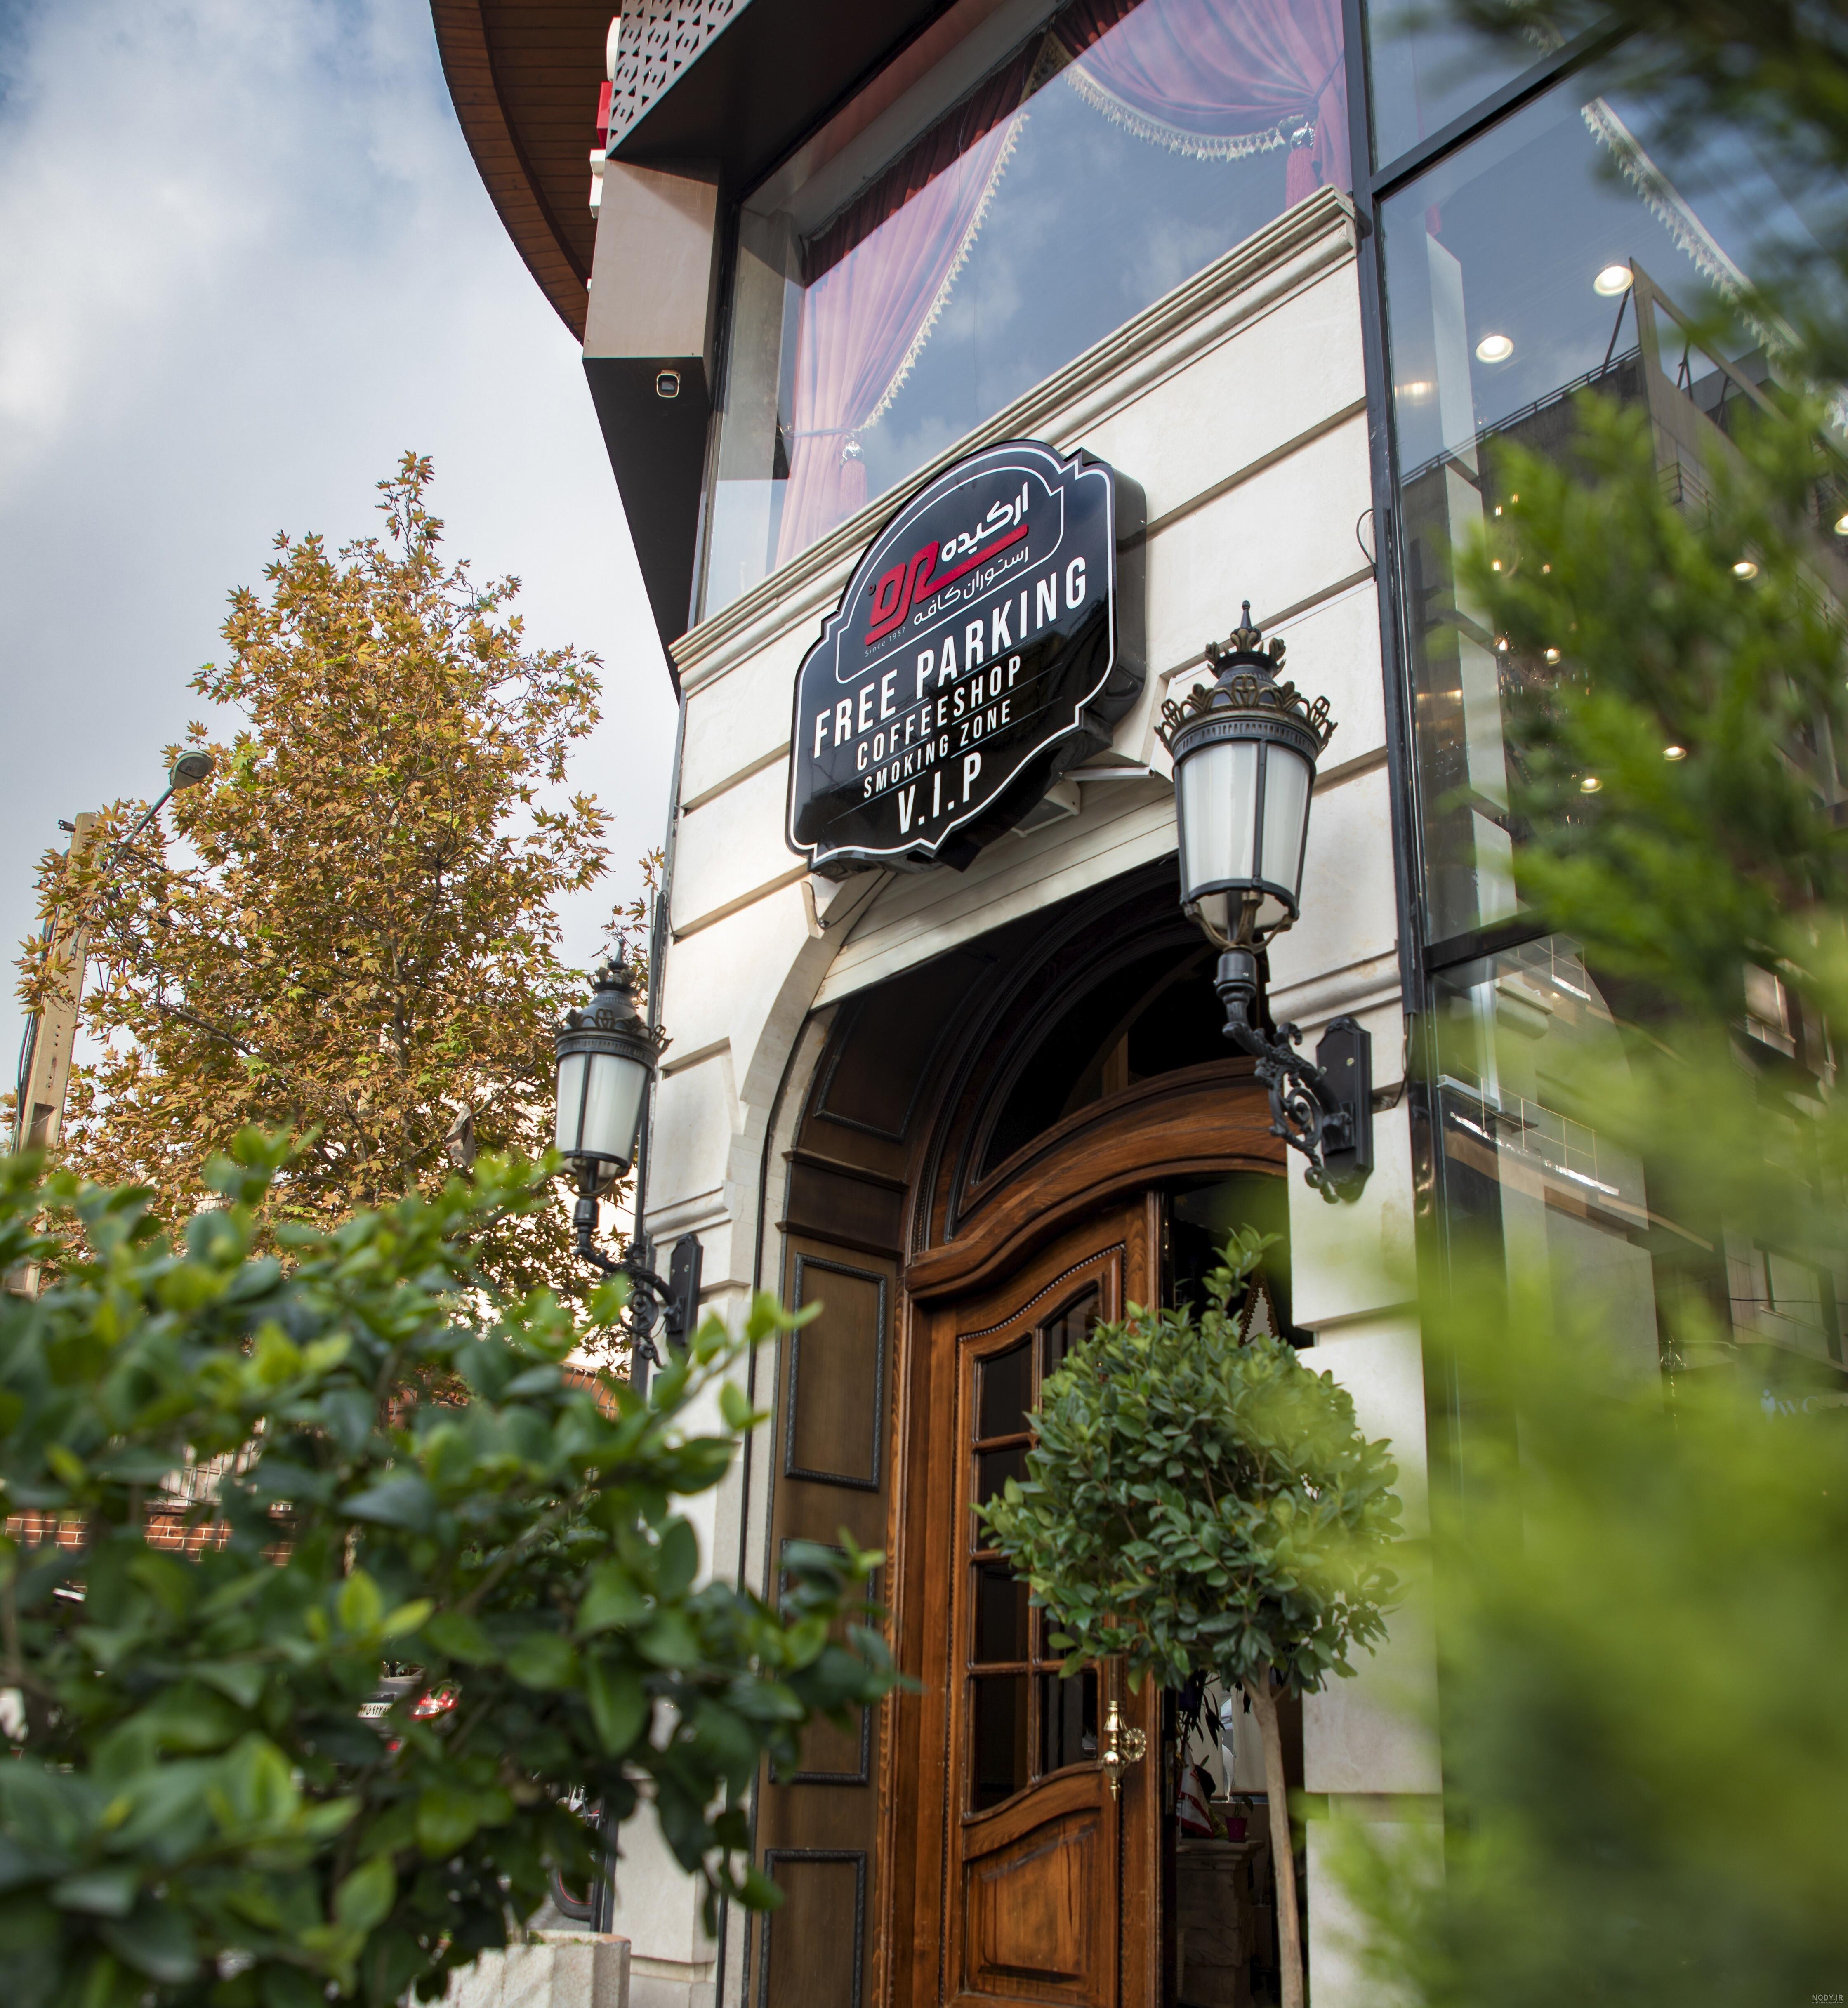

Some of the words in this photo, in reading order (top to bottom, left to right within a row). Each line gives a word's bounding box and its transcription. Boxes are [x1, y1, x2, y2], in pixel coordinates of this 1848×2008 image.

[941, 482, 1028, 562] ارکیده
[914, 586, 961, 625] کافه
[963, 546, 1028, 599] رستوران
[813, 669, 897, 759] FREE
[916, 556, 1086, 700] PARKING
[865, 640, 886, 657] Since
[889, 627, 905, 642] 1957
[857, 655, 1021, 771] COFFEESHOP
[863, 734, 948, 798] SMOKING
[960, 700, 1011, 746] ZONE
[898, 752, 981, 834] V.I.P
[1775, 1396, 1818, 1417] WC
